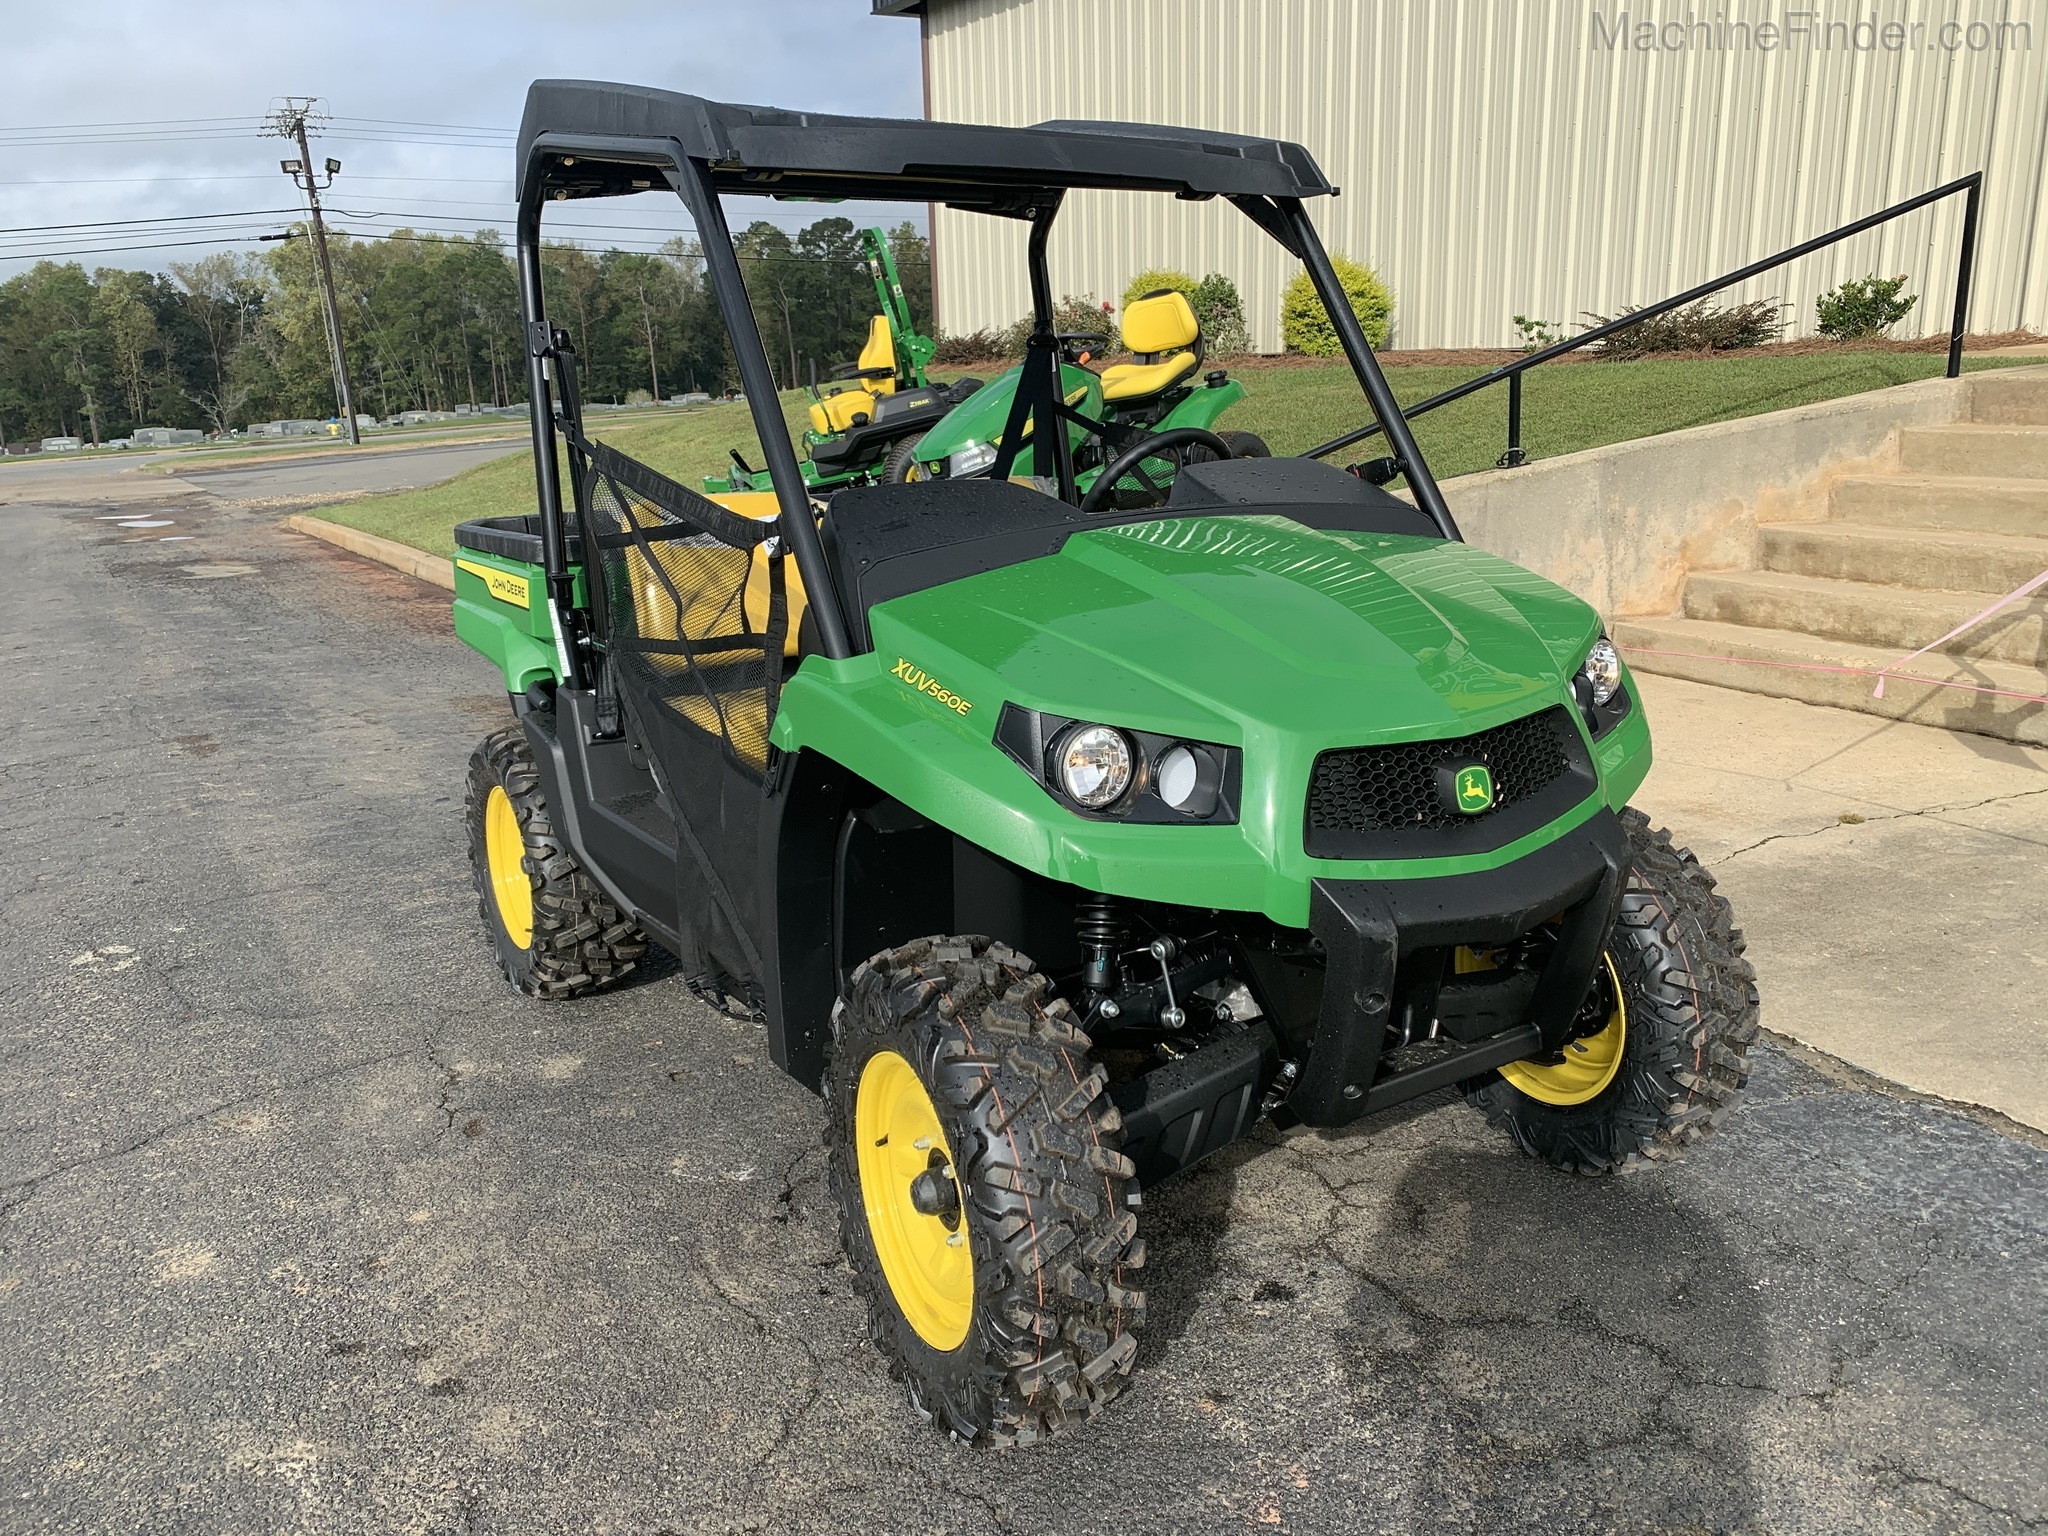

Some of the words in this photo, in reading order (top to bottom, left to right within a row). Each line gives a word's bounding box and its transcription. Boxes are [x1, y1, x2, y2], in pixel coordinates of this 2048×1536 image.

[492, 575, 507, 592] JOHN
[507, 579, 526, 599] DEERE
[889, 656, 974, 717] XUV560E
